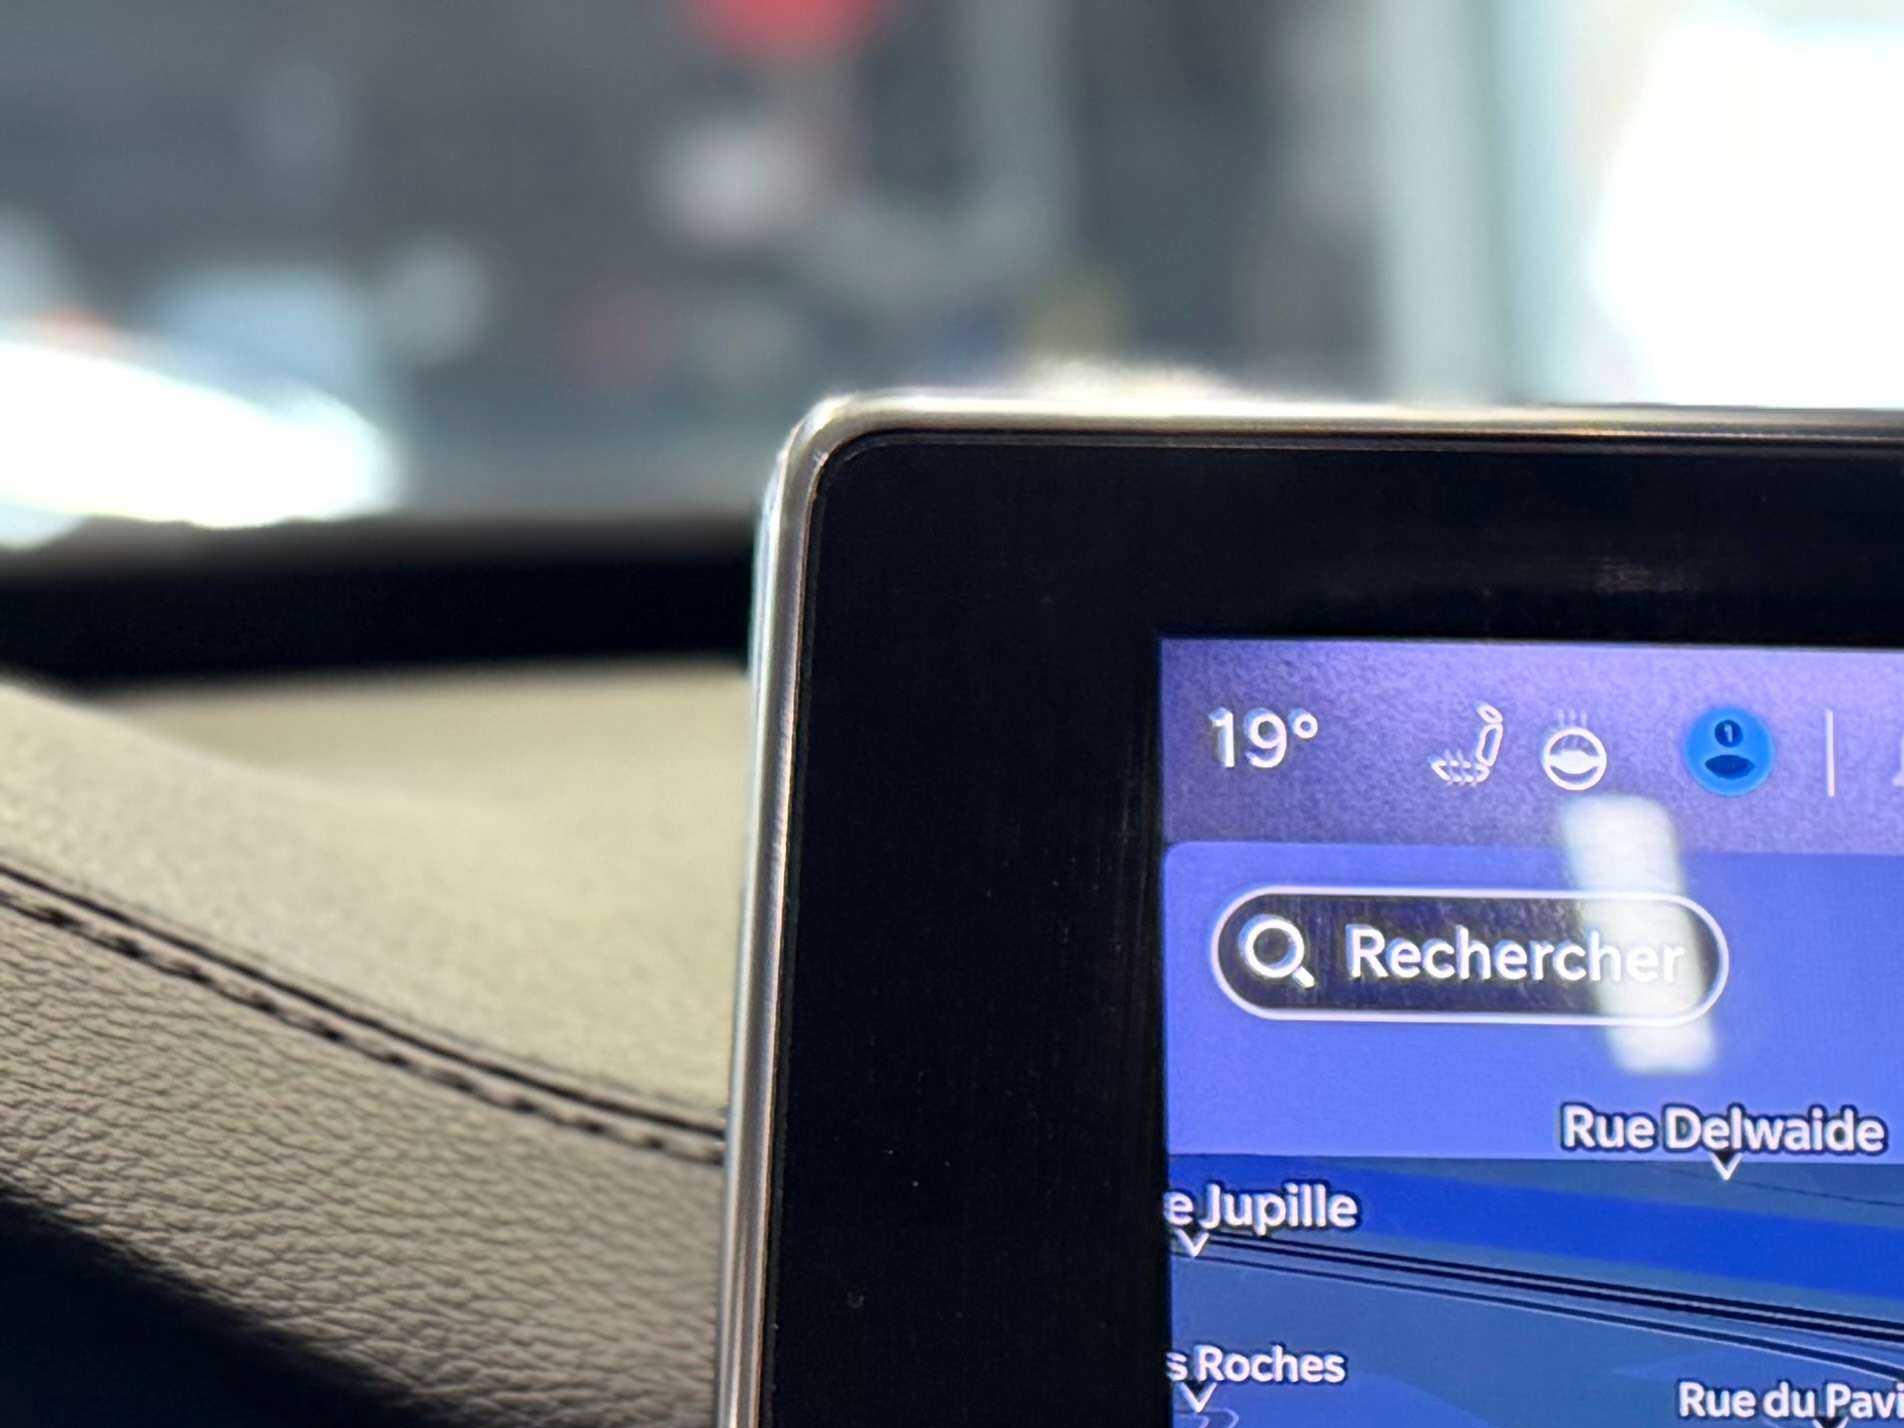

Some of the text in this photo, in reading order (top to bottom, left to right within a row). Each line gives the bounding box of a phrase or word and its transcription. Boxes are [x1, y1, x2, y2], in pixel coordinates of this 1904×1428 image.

[1344, 923, 1686, 985] Rechercher
[1561, 1104, 1887, 1154] Rue Delwaide
[1199, 1184, 1358, 1235] Jupille
[1197, 1344, 1345, 1384] Roches
[1678, 1383, 1756, 1420] Rue
[1762, 1382, 1816, 1420] du
